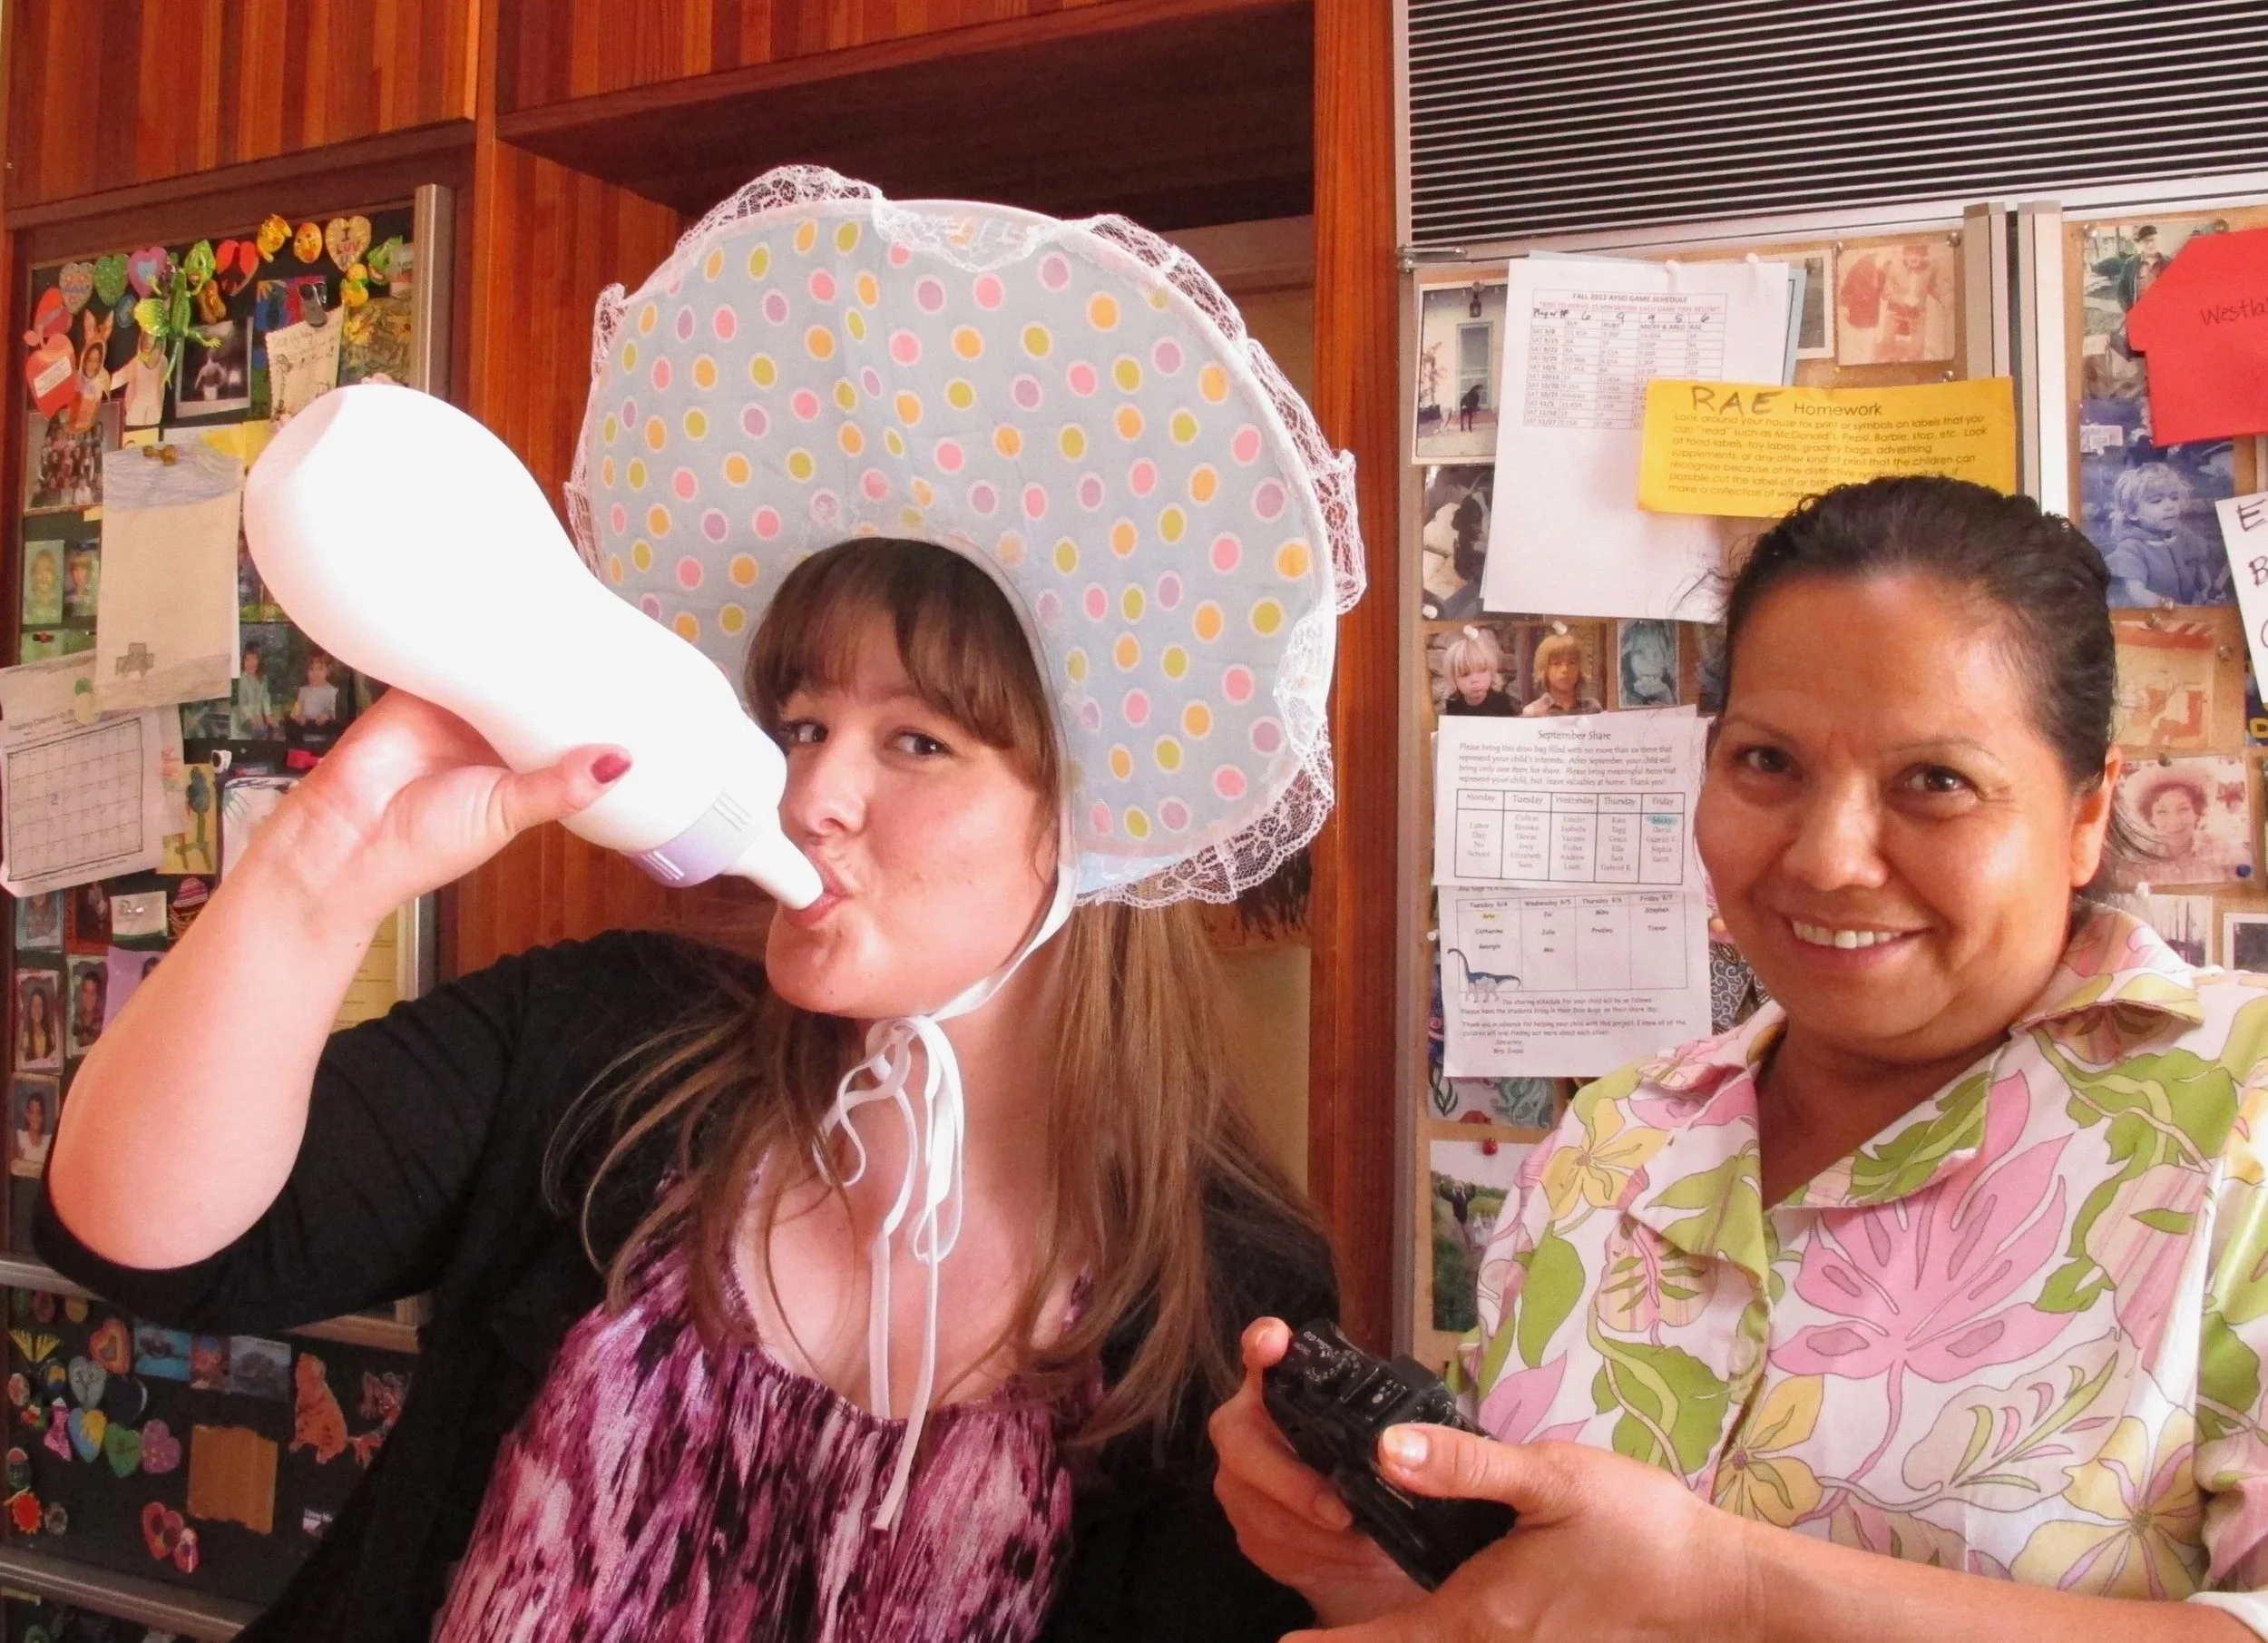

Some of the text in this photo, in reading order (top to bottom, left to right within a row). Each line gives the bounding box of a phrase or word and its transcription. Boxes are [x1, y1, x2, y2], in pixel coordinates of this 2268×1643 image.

[343, 227, 349, 240] I
[337, 240, 361, 254] LUV
[1581, 310, 1591, 320] 6
[1616, 311, 1625, 324] 9
[1647, 314, 1655, 324] 9
[1676, 314, 1683, 323] 5
[1701, 314, 1709, 322] 6
[2200, 298, 2268, 326] Westla
[1691, 386, 1784, 417] RAE
[1794, 402, 1883, 416] Homework
[1741, 416, 1762, 427] your
[1765, 418, 1795, 426] house
[1815, 420, 1838, 430] print
[1853, 421, 1893, 430] symbols
[1911, 419, 1941, 427] labels
[1943, 416, 1963, 425] that
[1966, 416, 1984, 425] you
[1735, 428, 1757, 436] such
[1965, 427, 1988, 436] Look
[1686, 437, 1710, 445] food
[1876, 445, 1932, 454] advertising
[1755, 453, 1774, 463] any
[1776, 454, 1804, 462] other
[1843, 456, 1867, 466] print
[1869, 456, 1890, 466] that
[1893, 458, 1910, 466] the
[1912, 456, 1953, 466] children
[1956, 455, 1976, 464] can
[1724, 463, 1769, 474] because
[1733, 474, 1748, 484] the
[1669, 484, 1696, 494] make
[1538, 729, 1611, 741] September Share
[1481, 743, 1501, 752] bring
[1534, 746, 1547, 754] bag
[1459, 765, 1477, 773] bring
[1588, 768, 1605, 777] bring
[1466, 792, 1674, 807] Monday Tuesday Wednesday Thursday Friday
